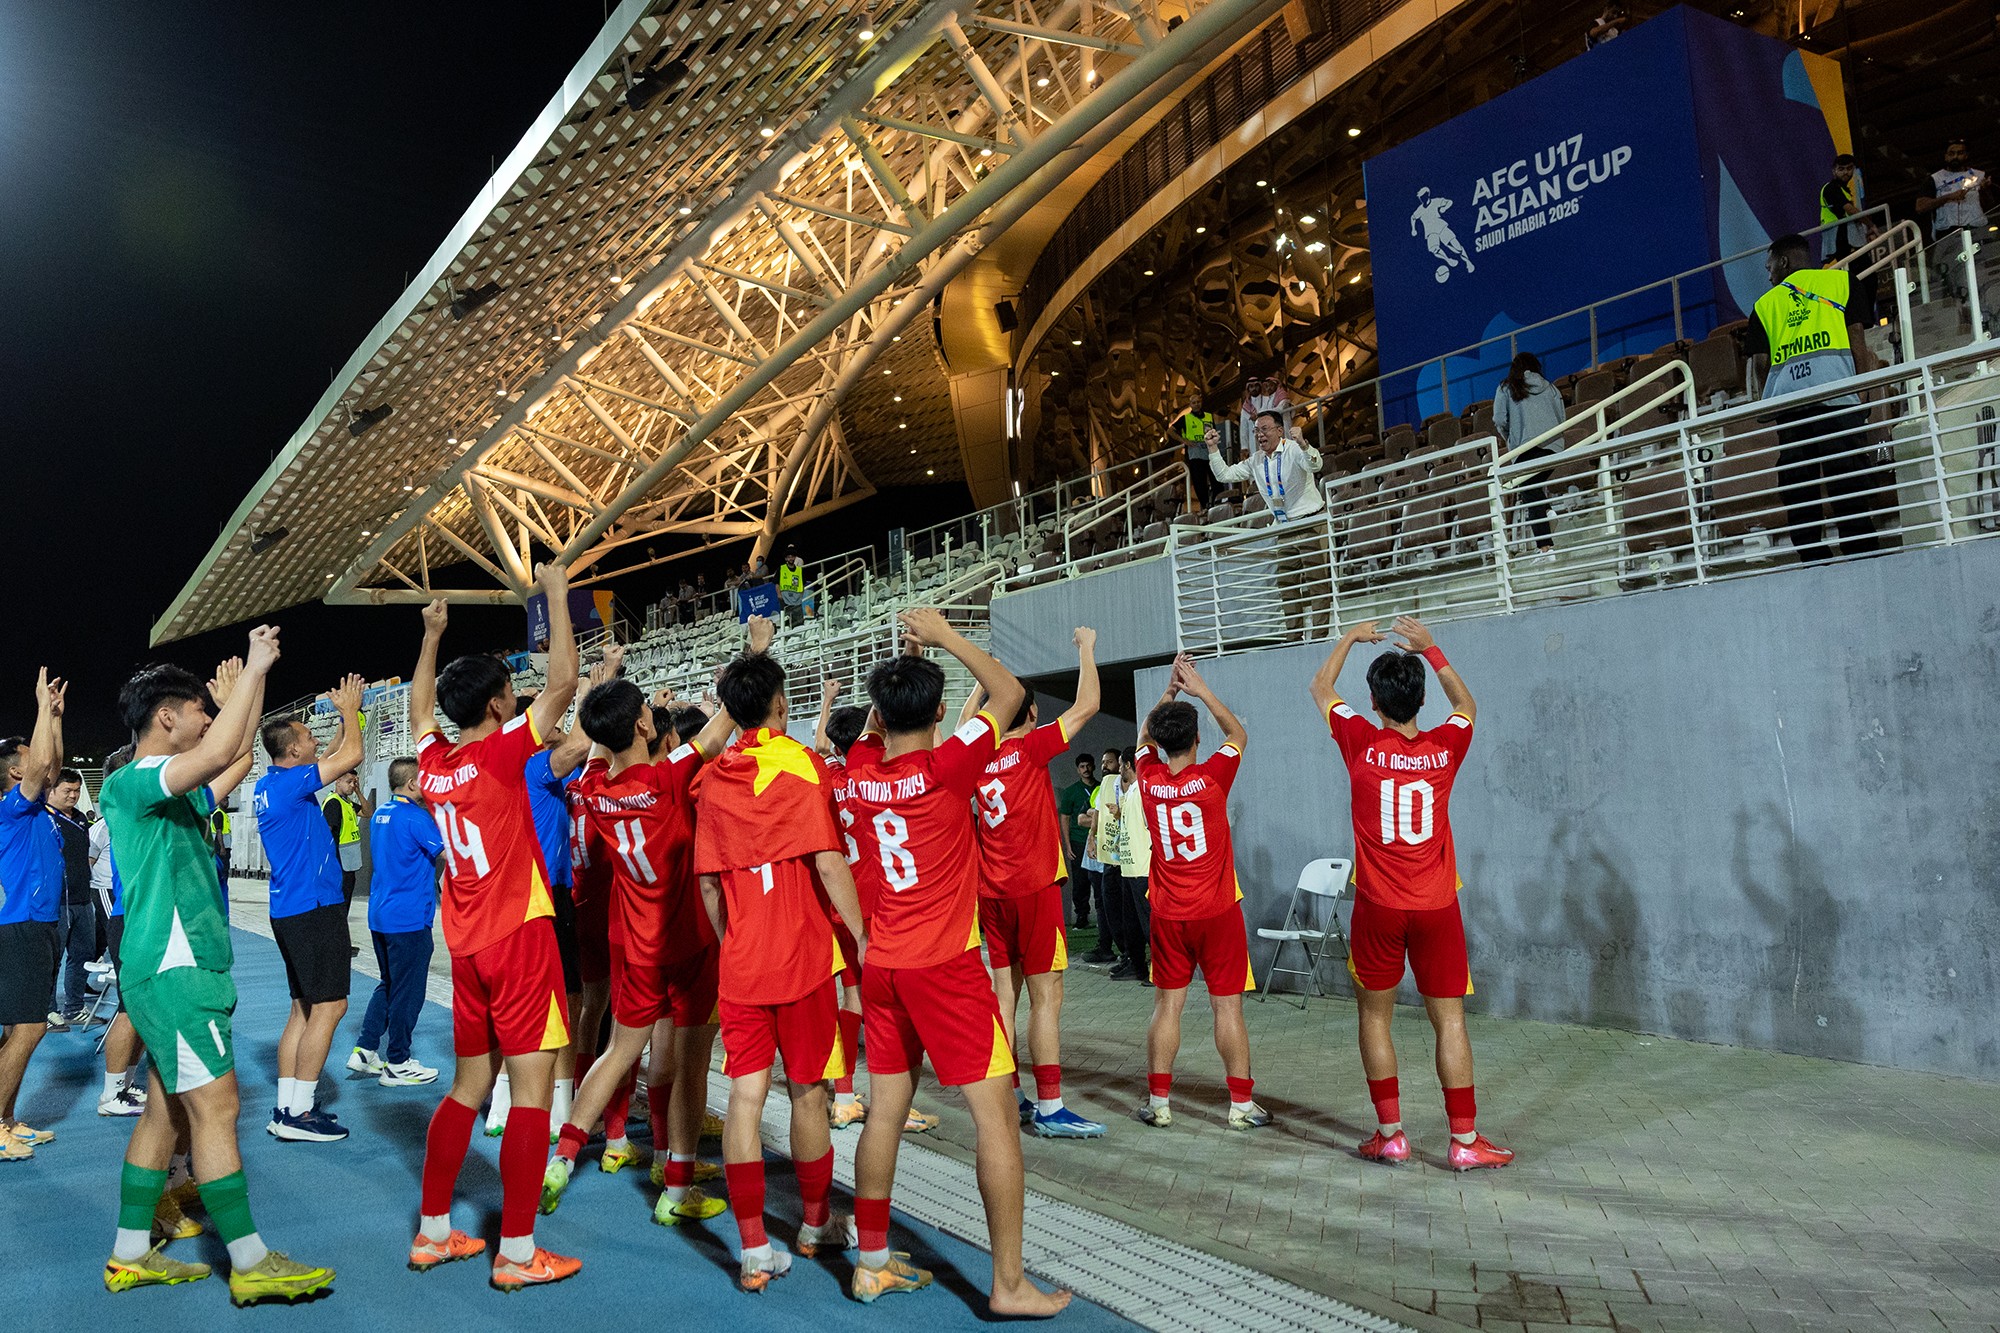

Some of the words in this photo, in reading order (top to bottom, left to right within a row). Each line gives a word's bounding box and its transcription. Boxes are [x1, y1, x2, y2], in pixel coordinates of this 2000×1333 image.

[1472, 159, 1528, 206] AFC
[1534, 133, 1583, 176] U17
[1474, 174, 1562, 234] ASIAN
[1566, 145, 1632, 192] CUP
[1474, 227, 1506, 253] SAUDI
[1508, 210, 1547, 240] ARABIA
[1789, 361, 1812, 381] 1225
[858, 780, 893, 802] MINH
[894, 772, 926, 800] THUY
[979, 777, 1008, 829] 9
[1380, 778, 1434, 845] 10
[432, 799, 491, 880] 14
[613, 816, 658, 885] 11
[872, 807, 920, 893] 8
[1156, 801, 1208, 862] 19
